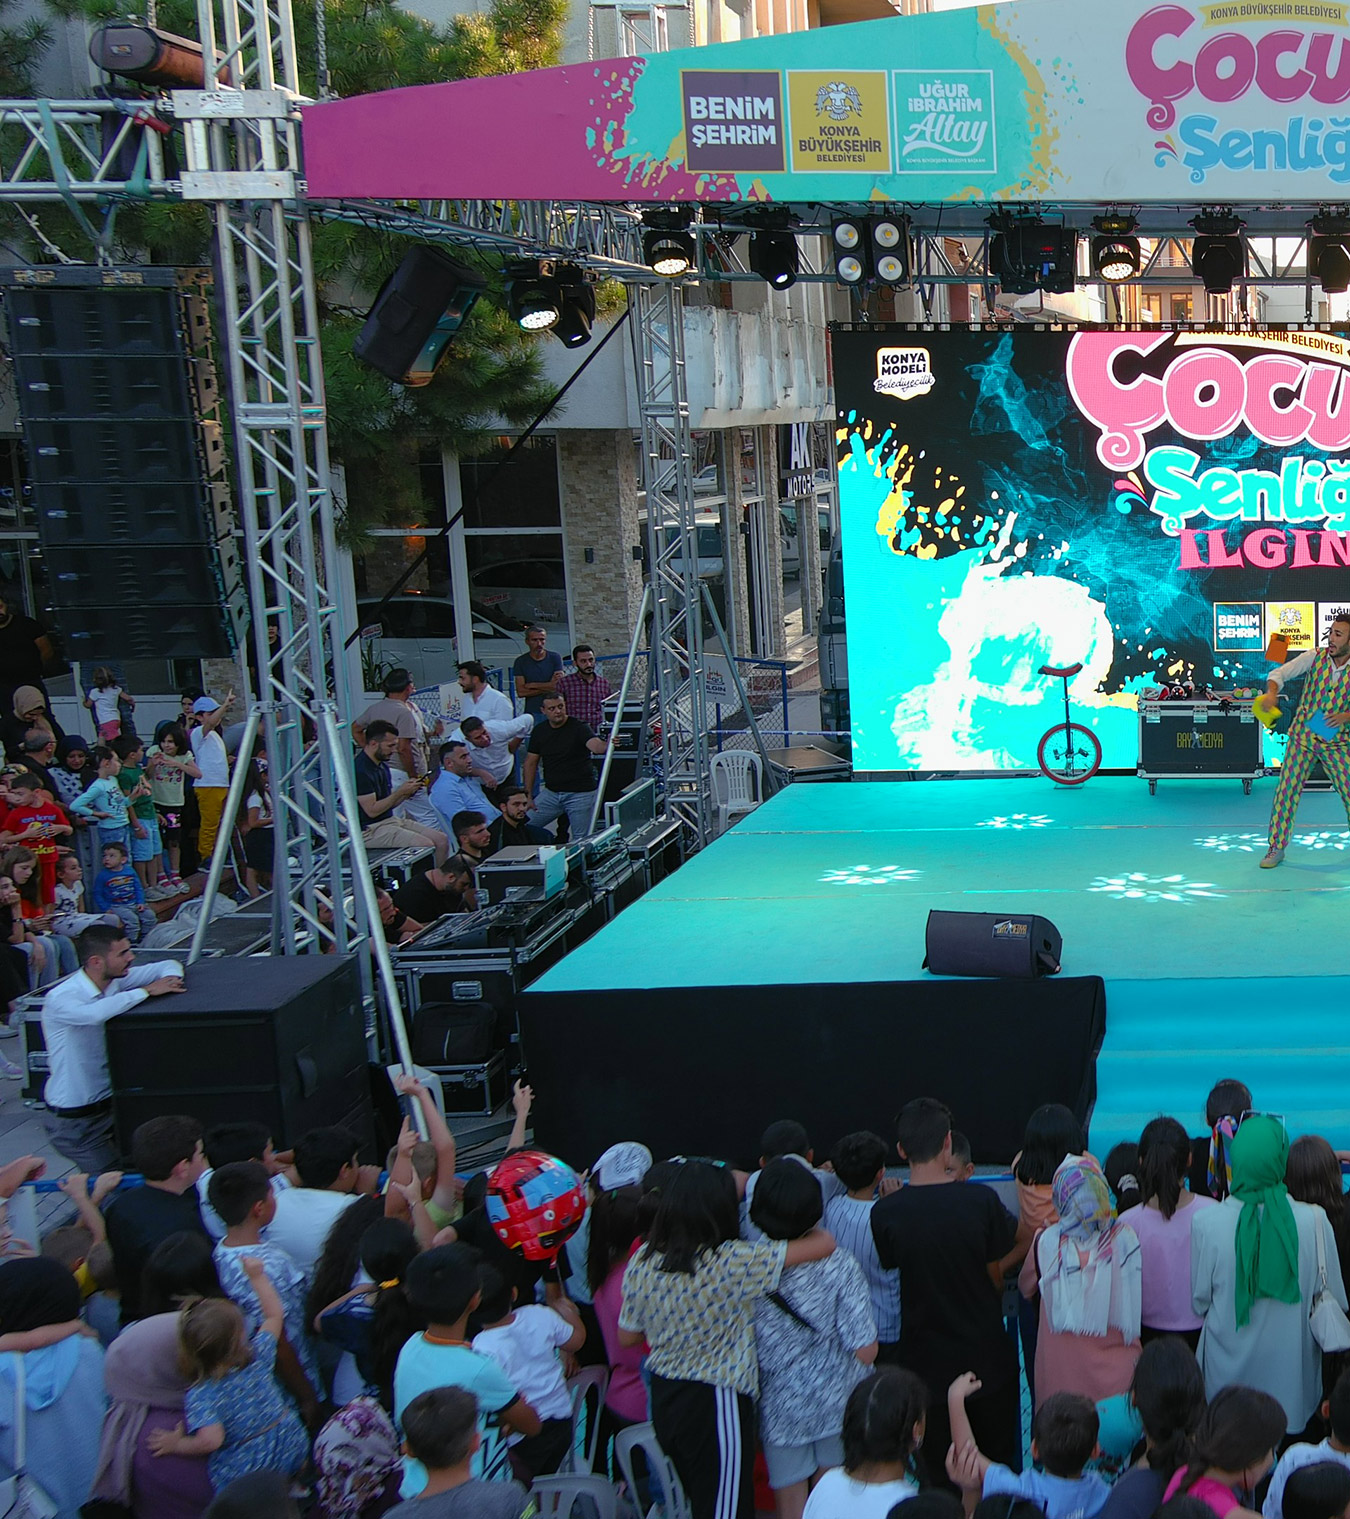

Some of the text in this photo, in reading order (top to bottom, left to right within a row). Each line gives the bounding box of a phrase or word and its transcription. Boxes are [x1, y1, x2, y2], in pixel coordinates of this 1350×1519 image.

[1210, 3, 1341, 20] KONYA BÜYÜKŞEHİR BELEDİYESİ
[919, 80, 970, 98] UĞUR
[689, 96, 775, 120] BENİM
[908, 97, 982, 112] İBRAHİM
[691, 124, 777, 149] ŞEHRİM
[819, 126, 861, 137] KONYA
[902, 112, 988, 147] Altay
[799, 138, 882, 154] BÜYÜKŞEHİR
[816, 153, 866, 163] BELEDİYESİ
[1291, 333, 1344, 355] BELEDİYESİ
[882, 352, 926, 365] KONYA
[881, 364, 926, 375] MODELİ
[791, 422, 811, 470] AK
